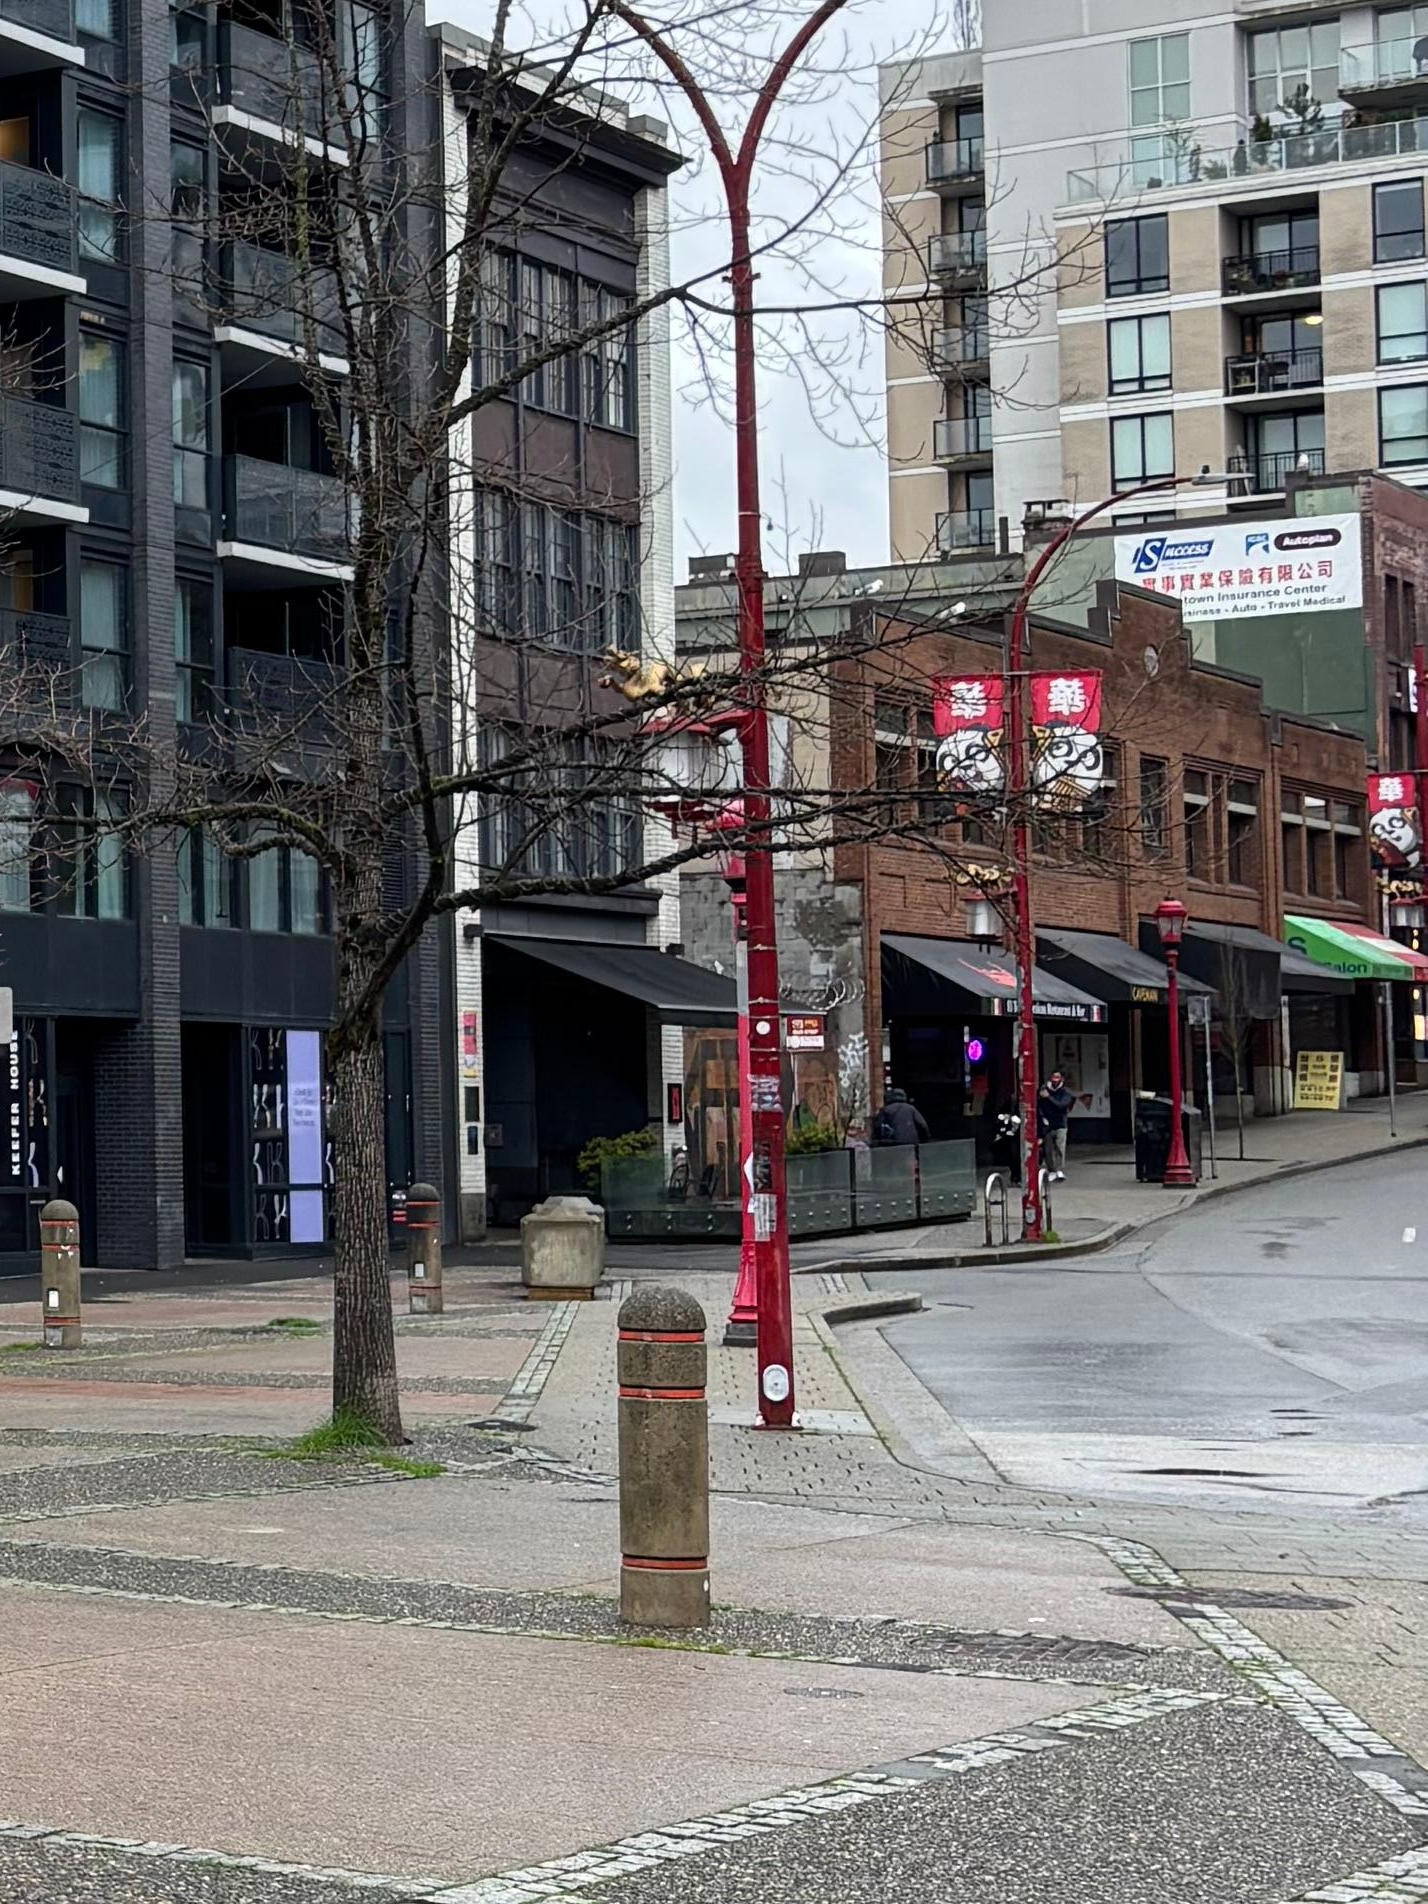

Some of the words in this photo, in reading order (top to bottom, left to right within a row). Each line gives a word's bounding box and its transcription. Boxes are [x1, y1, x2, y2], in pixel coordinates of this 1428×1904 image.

[1282, 533, 1334, 549] Autoplan
[1217, 587, 1281, 601] Insurance
[1284, 583, 1328, 594] Center
[1231, 604, 1257, 613] Auto
[1267, 598, 1301, 610] Travel
[1303, 595, 1346, 606] Medical
[1047, 678, 1085, 716] 華
